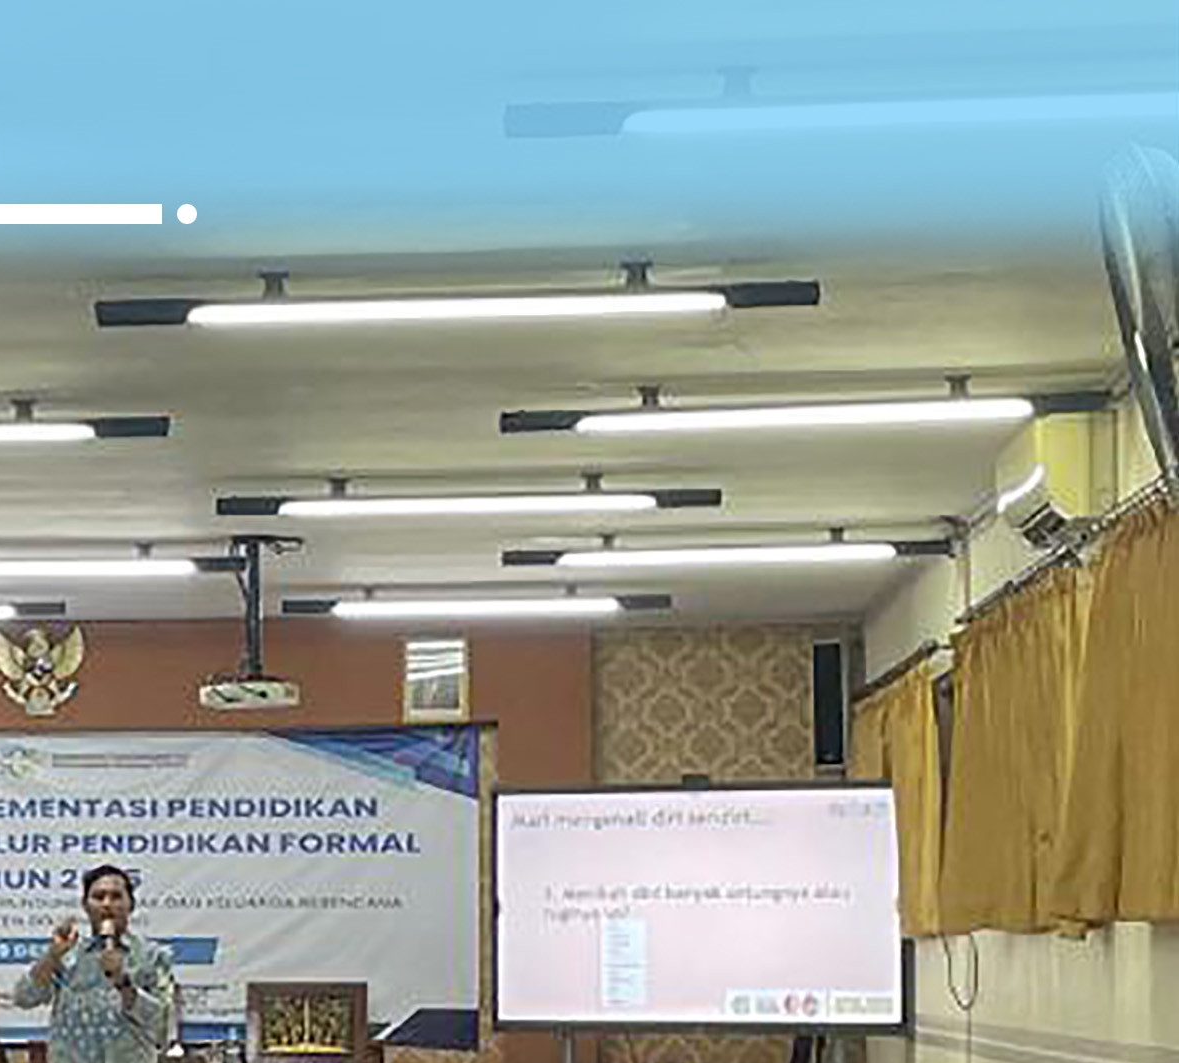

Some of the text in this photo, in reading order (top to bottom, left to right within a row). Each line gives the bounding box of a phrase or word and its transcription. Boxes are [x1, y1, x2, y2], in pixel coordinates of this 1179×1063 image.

[168, 798, 378, 818] PENDIDIKAN
[62, 834, 270, 853] PENDIDIKAN
[280, 834, 420, 853] FORMAL
[61, 869, 142, 889] 25
